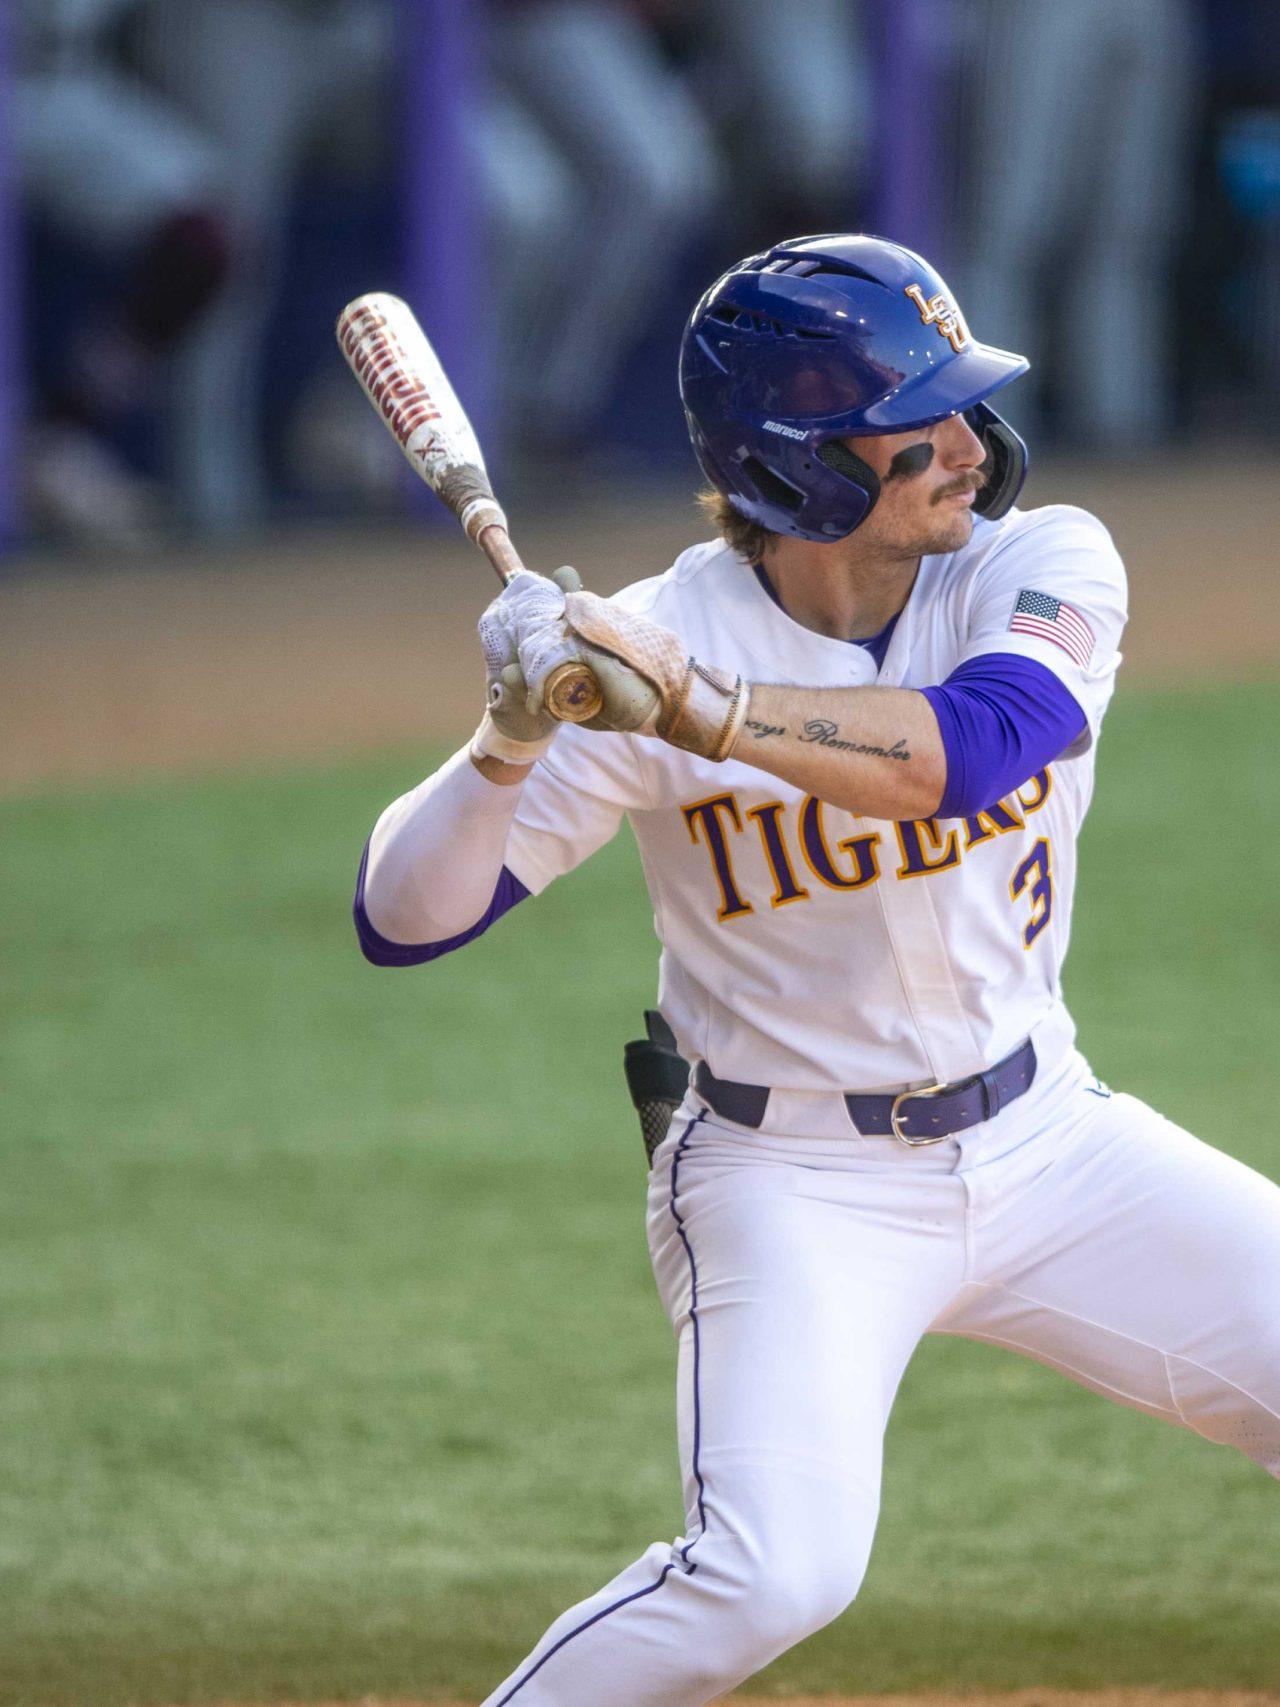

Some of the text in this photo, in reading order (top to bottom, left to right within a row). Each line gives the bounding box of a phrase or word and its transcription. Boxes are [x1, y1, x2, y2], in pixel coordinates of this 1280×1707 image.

[904, 283, 968, 353] LSU
[762, 420, 810, 441] marucci
[744, 719, 912, 761] ays Remember
[1009, 836, 1052, 950] 3
